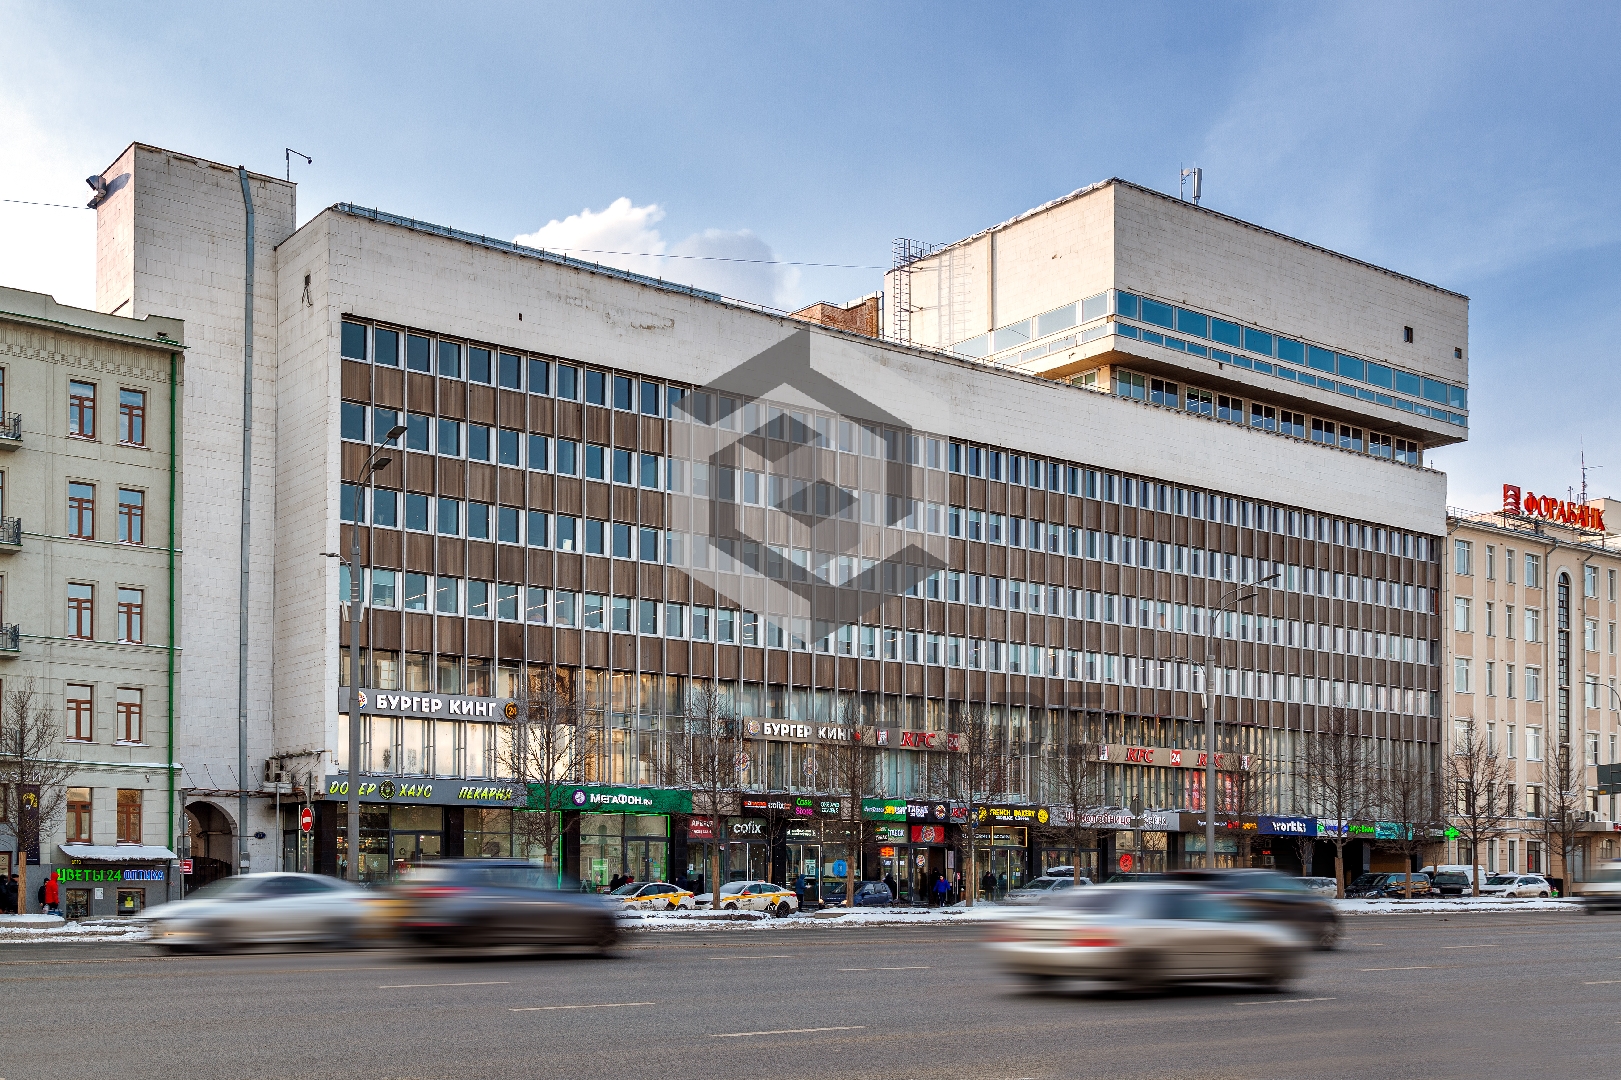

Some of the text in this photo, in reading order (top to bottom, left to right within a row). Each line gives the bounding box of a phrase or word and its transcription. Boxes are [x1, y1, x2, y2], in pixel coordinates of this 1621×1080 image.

[1524, 492, 1605, 531] ФОРАБАНК
[376, 694, 497, 717] БУРГЕР КИНГ
[763, 722, 853, 741] БУРГЕР КИНГ
[900, 731, 936, 749] KFC
[948, 737, 959, 747] 24
[1125, 748, 1155, 763] KFC
[1171, 753, 1181, 763] 24
[1197, 753, 1224, 768] KC
[329, 780, 433, 798] ДОЕР ХАУС
[458, 786, 513, 801] ПЕКАРНЯ
[733, 820, 762, 834] cofix
[57, 868, 121, 884] ЦВЕТЫ 24
[123, 869, 164, 881] ОПТИКА
